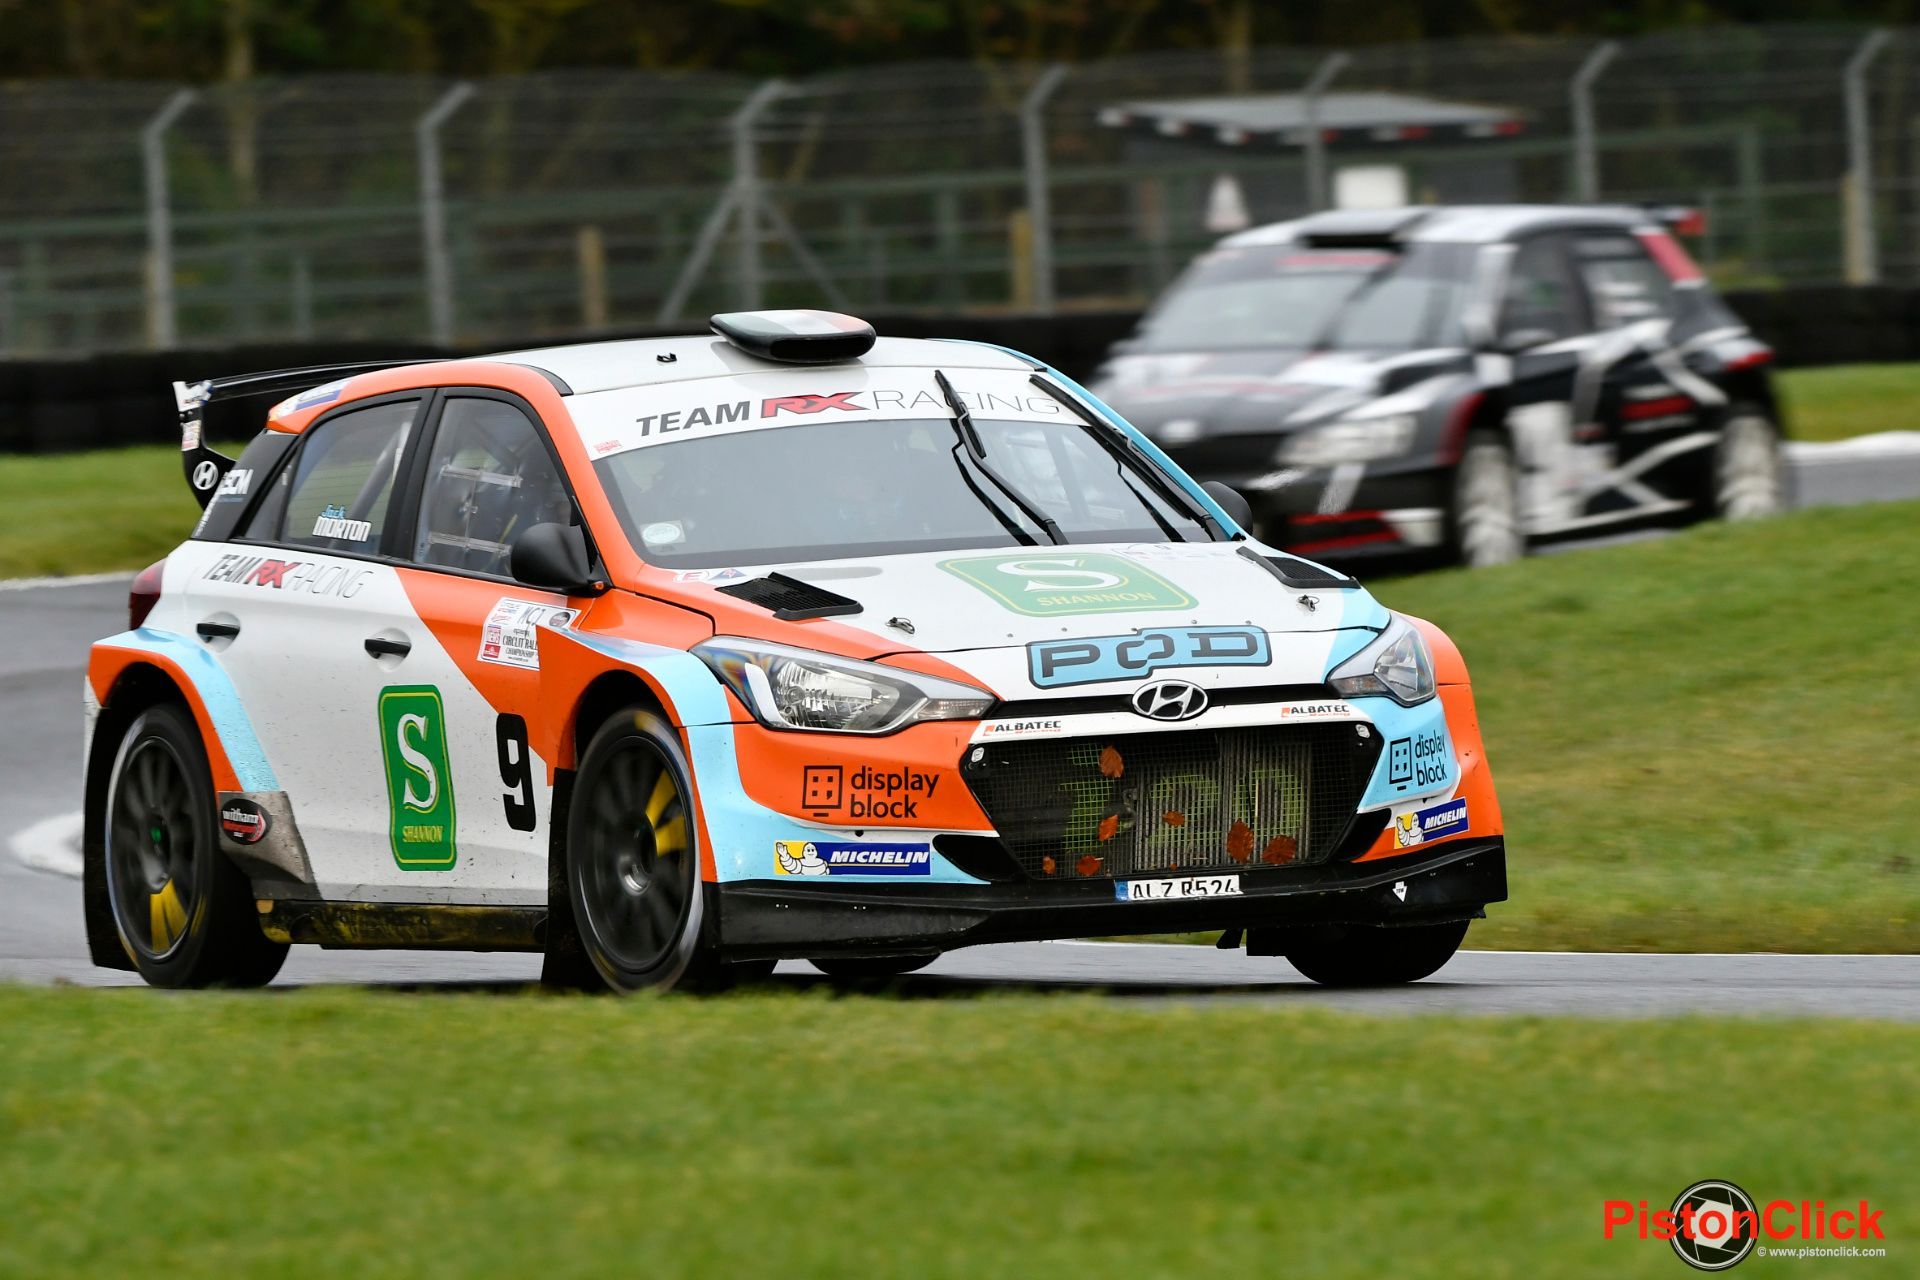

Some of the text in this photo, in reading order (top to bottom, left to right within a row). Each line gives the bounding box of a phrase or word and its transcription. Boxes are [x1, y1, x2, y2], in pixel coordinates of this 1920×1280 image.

[636, 390, 1060, 437] TEAM RX RACING
[202, 554, 374, 599] TEAM RX RACING
[996, 559, 1130, 592] S
[1037, 592, 1157, 607] SHANNON
[502, 634, 524, 649] CIRCUIT
[1042, 632, 1258, 678] POD
[1291, 704, 1350, 714] ALBATEC
[995, 721, 1062, 732] ALBATEC
[1415, 729, 1446, 762] display
[397, 713, 438, 814] S
[496, 712, 536, 832] 9
[1416, 761, 1448, 786] block
[851, 765, 940, 798] display
[850, 794, 918, 819] block
[1424, 806, 1467, 830] MICHELIN
[402, 825, 443, 844] SHANNON
[830, 851, 929, 864] MICHELIN
